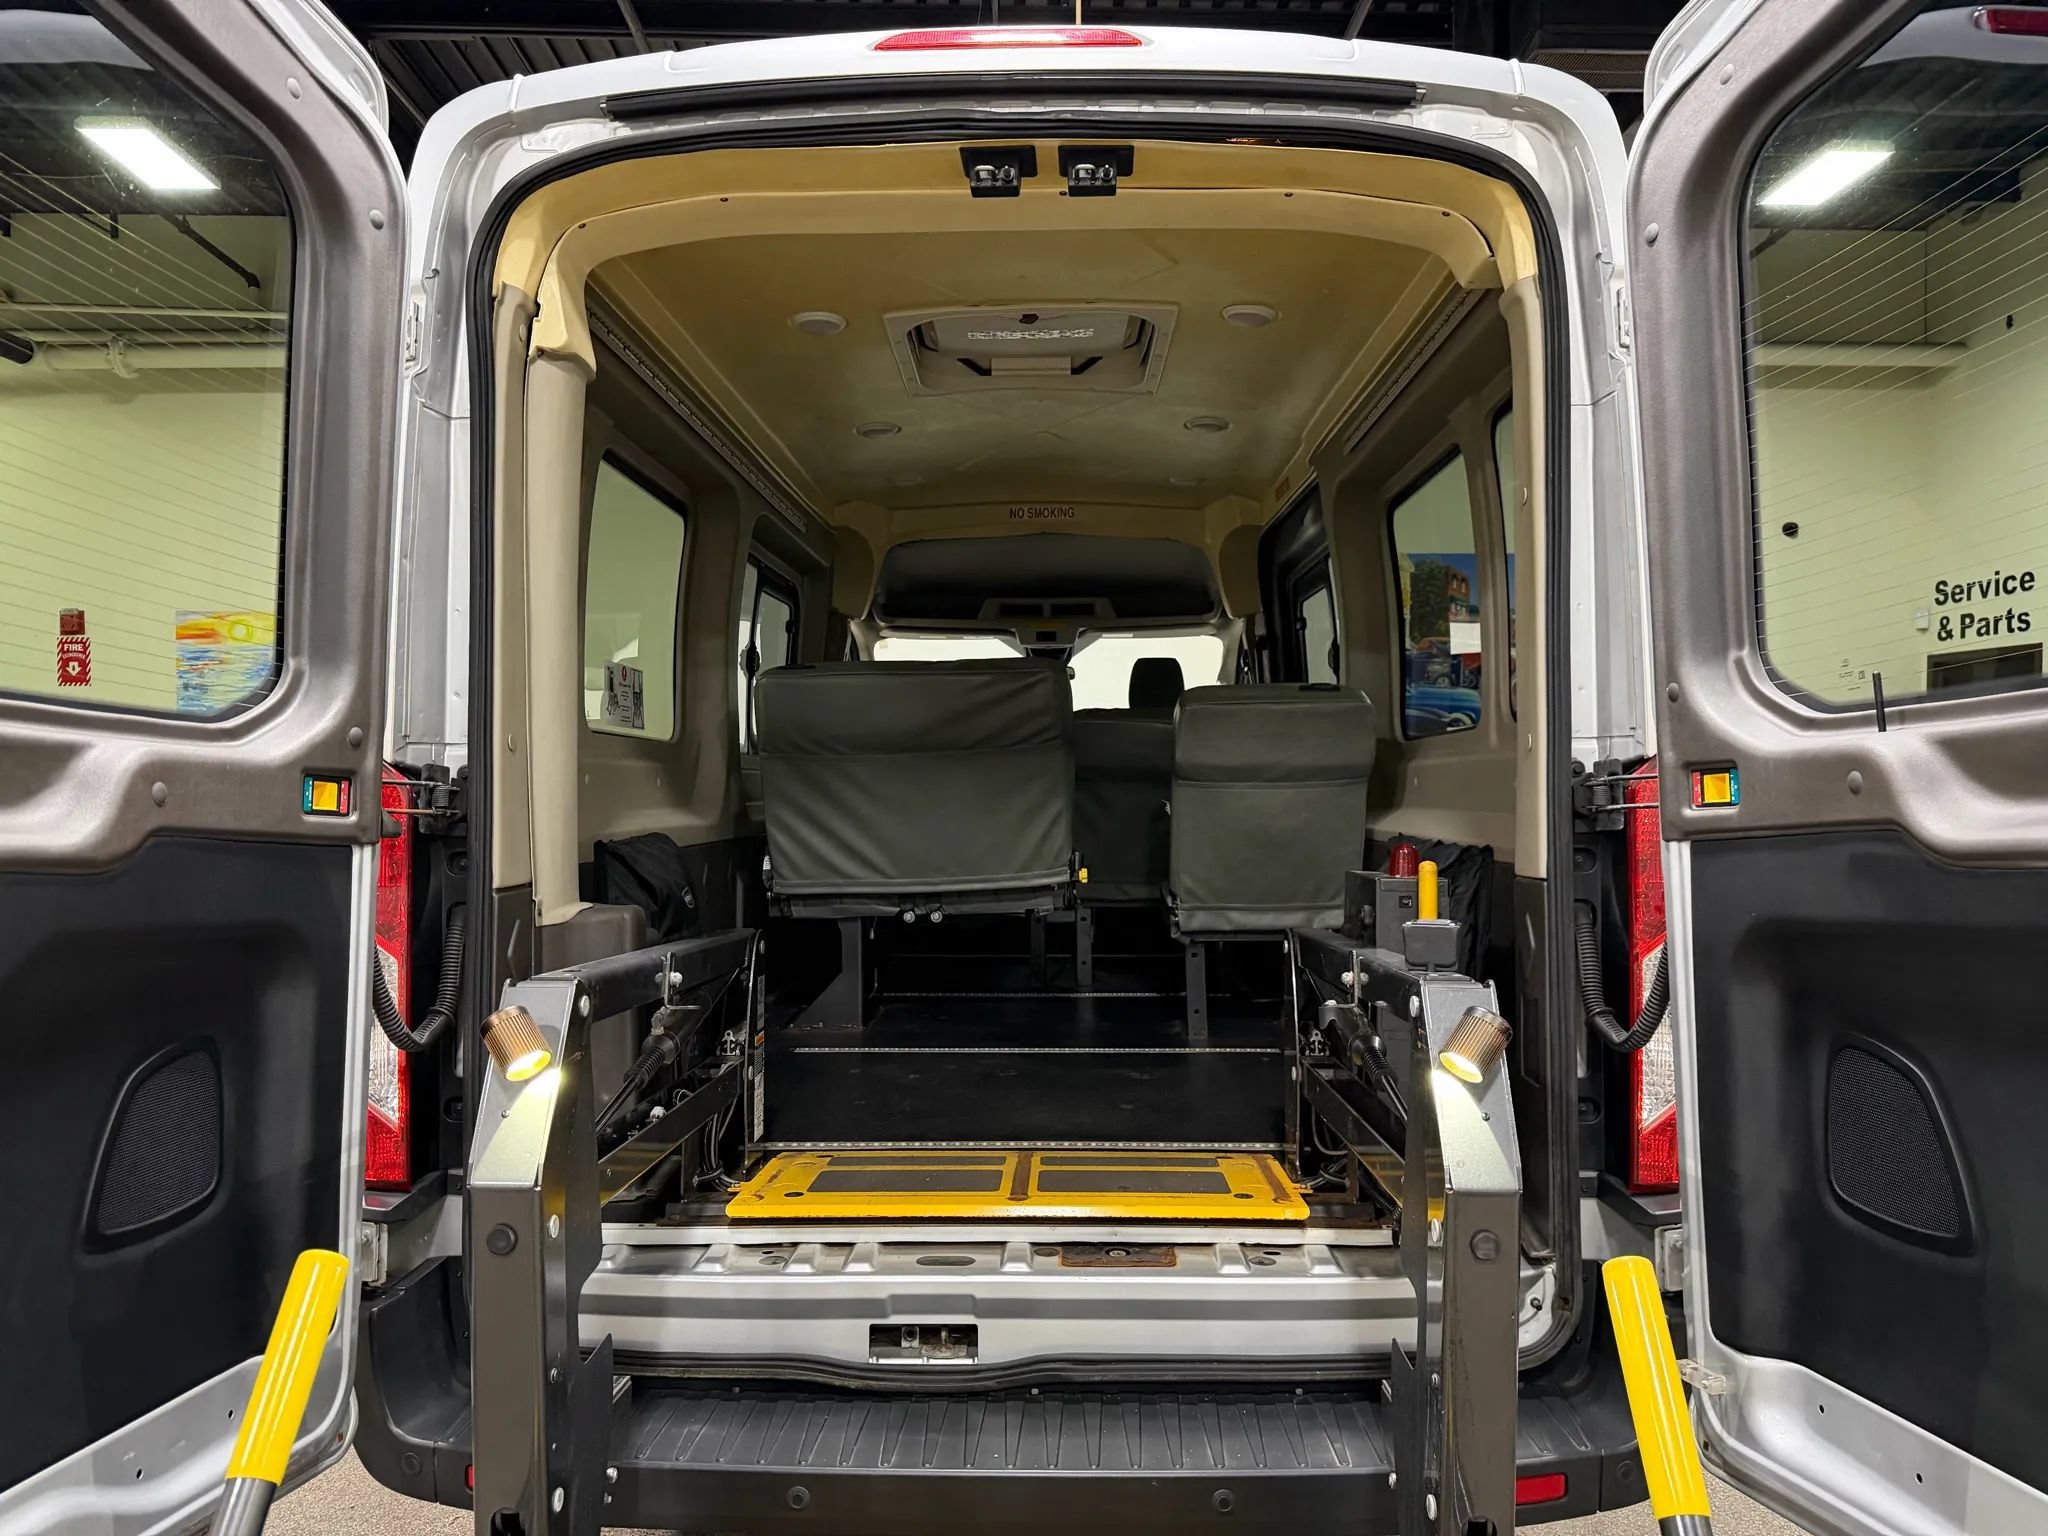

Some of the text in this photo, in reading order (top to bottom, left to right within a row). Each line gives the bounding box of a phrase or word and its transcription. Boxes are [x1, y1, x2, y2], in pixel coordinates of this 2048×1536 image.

[1009, 506, 1075, 519] NO SMOKING
[1934, 570, 2036, 606] Service
[1937, 607, 2031, 641] & Parts
[64, 643, 84, 652] FIRE
